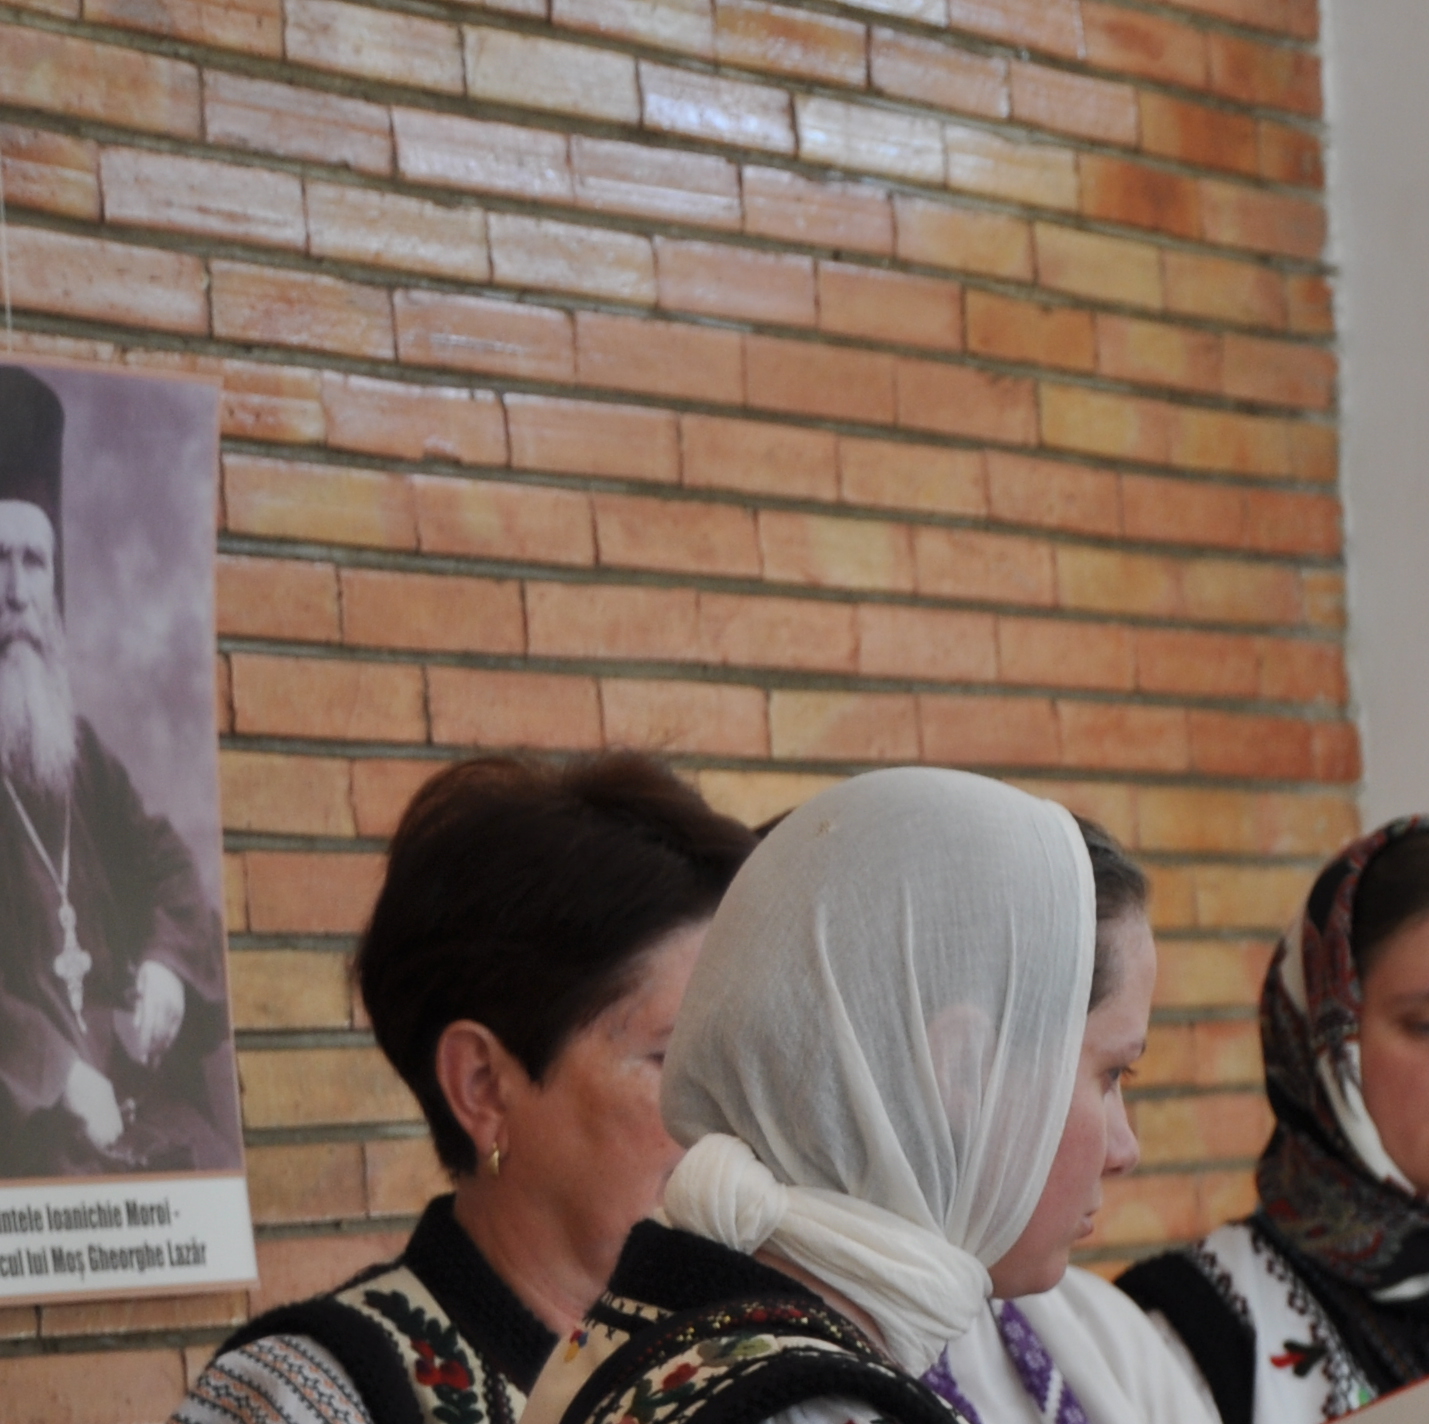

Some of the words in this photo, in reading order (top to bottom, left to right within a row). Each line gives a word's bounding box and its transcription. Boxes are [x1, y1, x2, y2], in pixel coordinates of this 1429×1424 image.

[0, 1204, 43, 1233] ntele
[45, 1200, 122, 1232] Ioanichie
[26, 1246, 49, 1275] lui
[87, 1240, 165, 1274] Gheorghe
